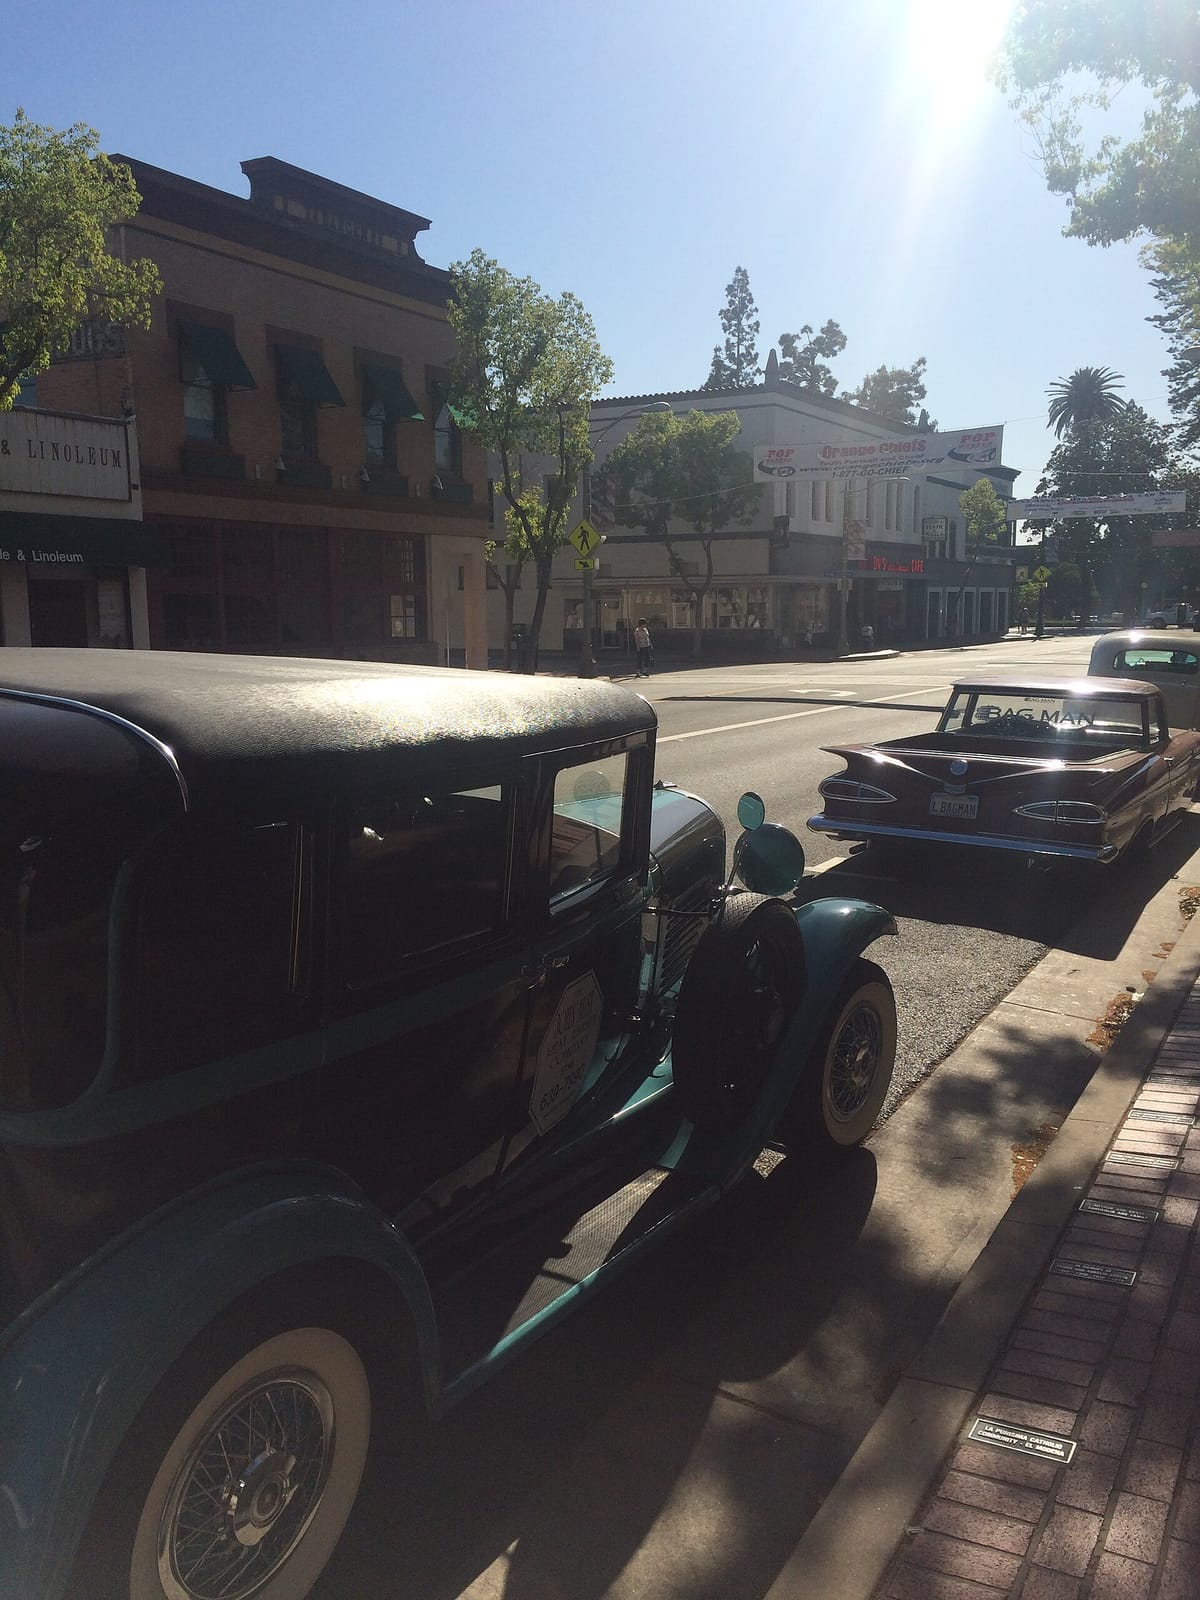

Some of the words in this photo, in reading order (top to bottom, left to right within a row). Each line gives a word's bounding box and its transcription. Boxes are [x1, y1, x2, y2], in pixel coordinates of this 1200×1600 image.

[959, 431, 996, 443] POP
[1, 439, 11, 455] &
[27, 439, 122, 468] LINOLEUM
[765, 448, 795, 458] POP
[821, 445, 876, 459] Orange
[880, 439, 927, 454] Chiefs
[17, 550, 26, 561] &
[32, 550, 84, 563] Linoleum
[988, 706, 1034, 722] BAG
[1041, 709, 1096, 725] MAN
[941, 801, 976, 816] BAGMAN
[978, 1430, 1018, 1444] COMMUNITY
